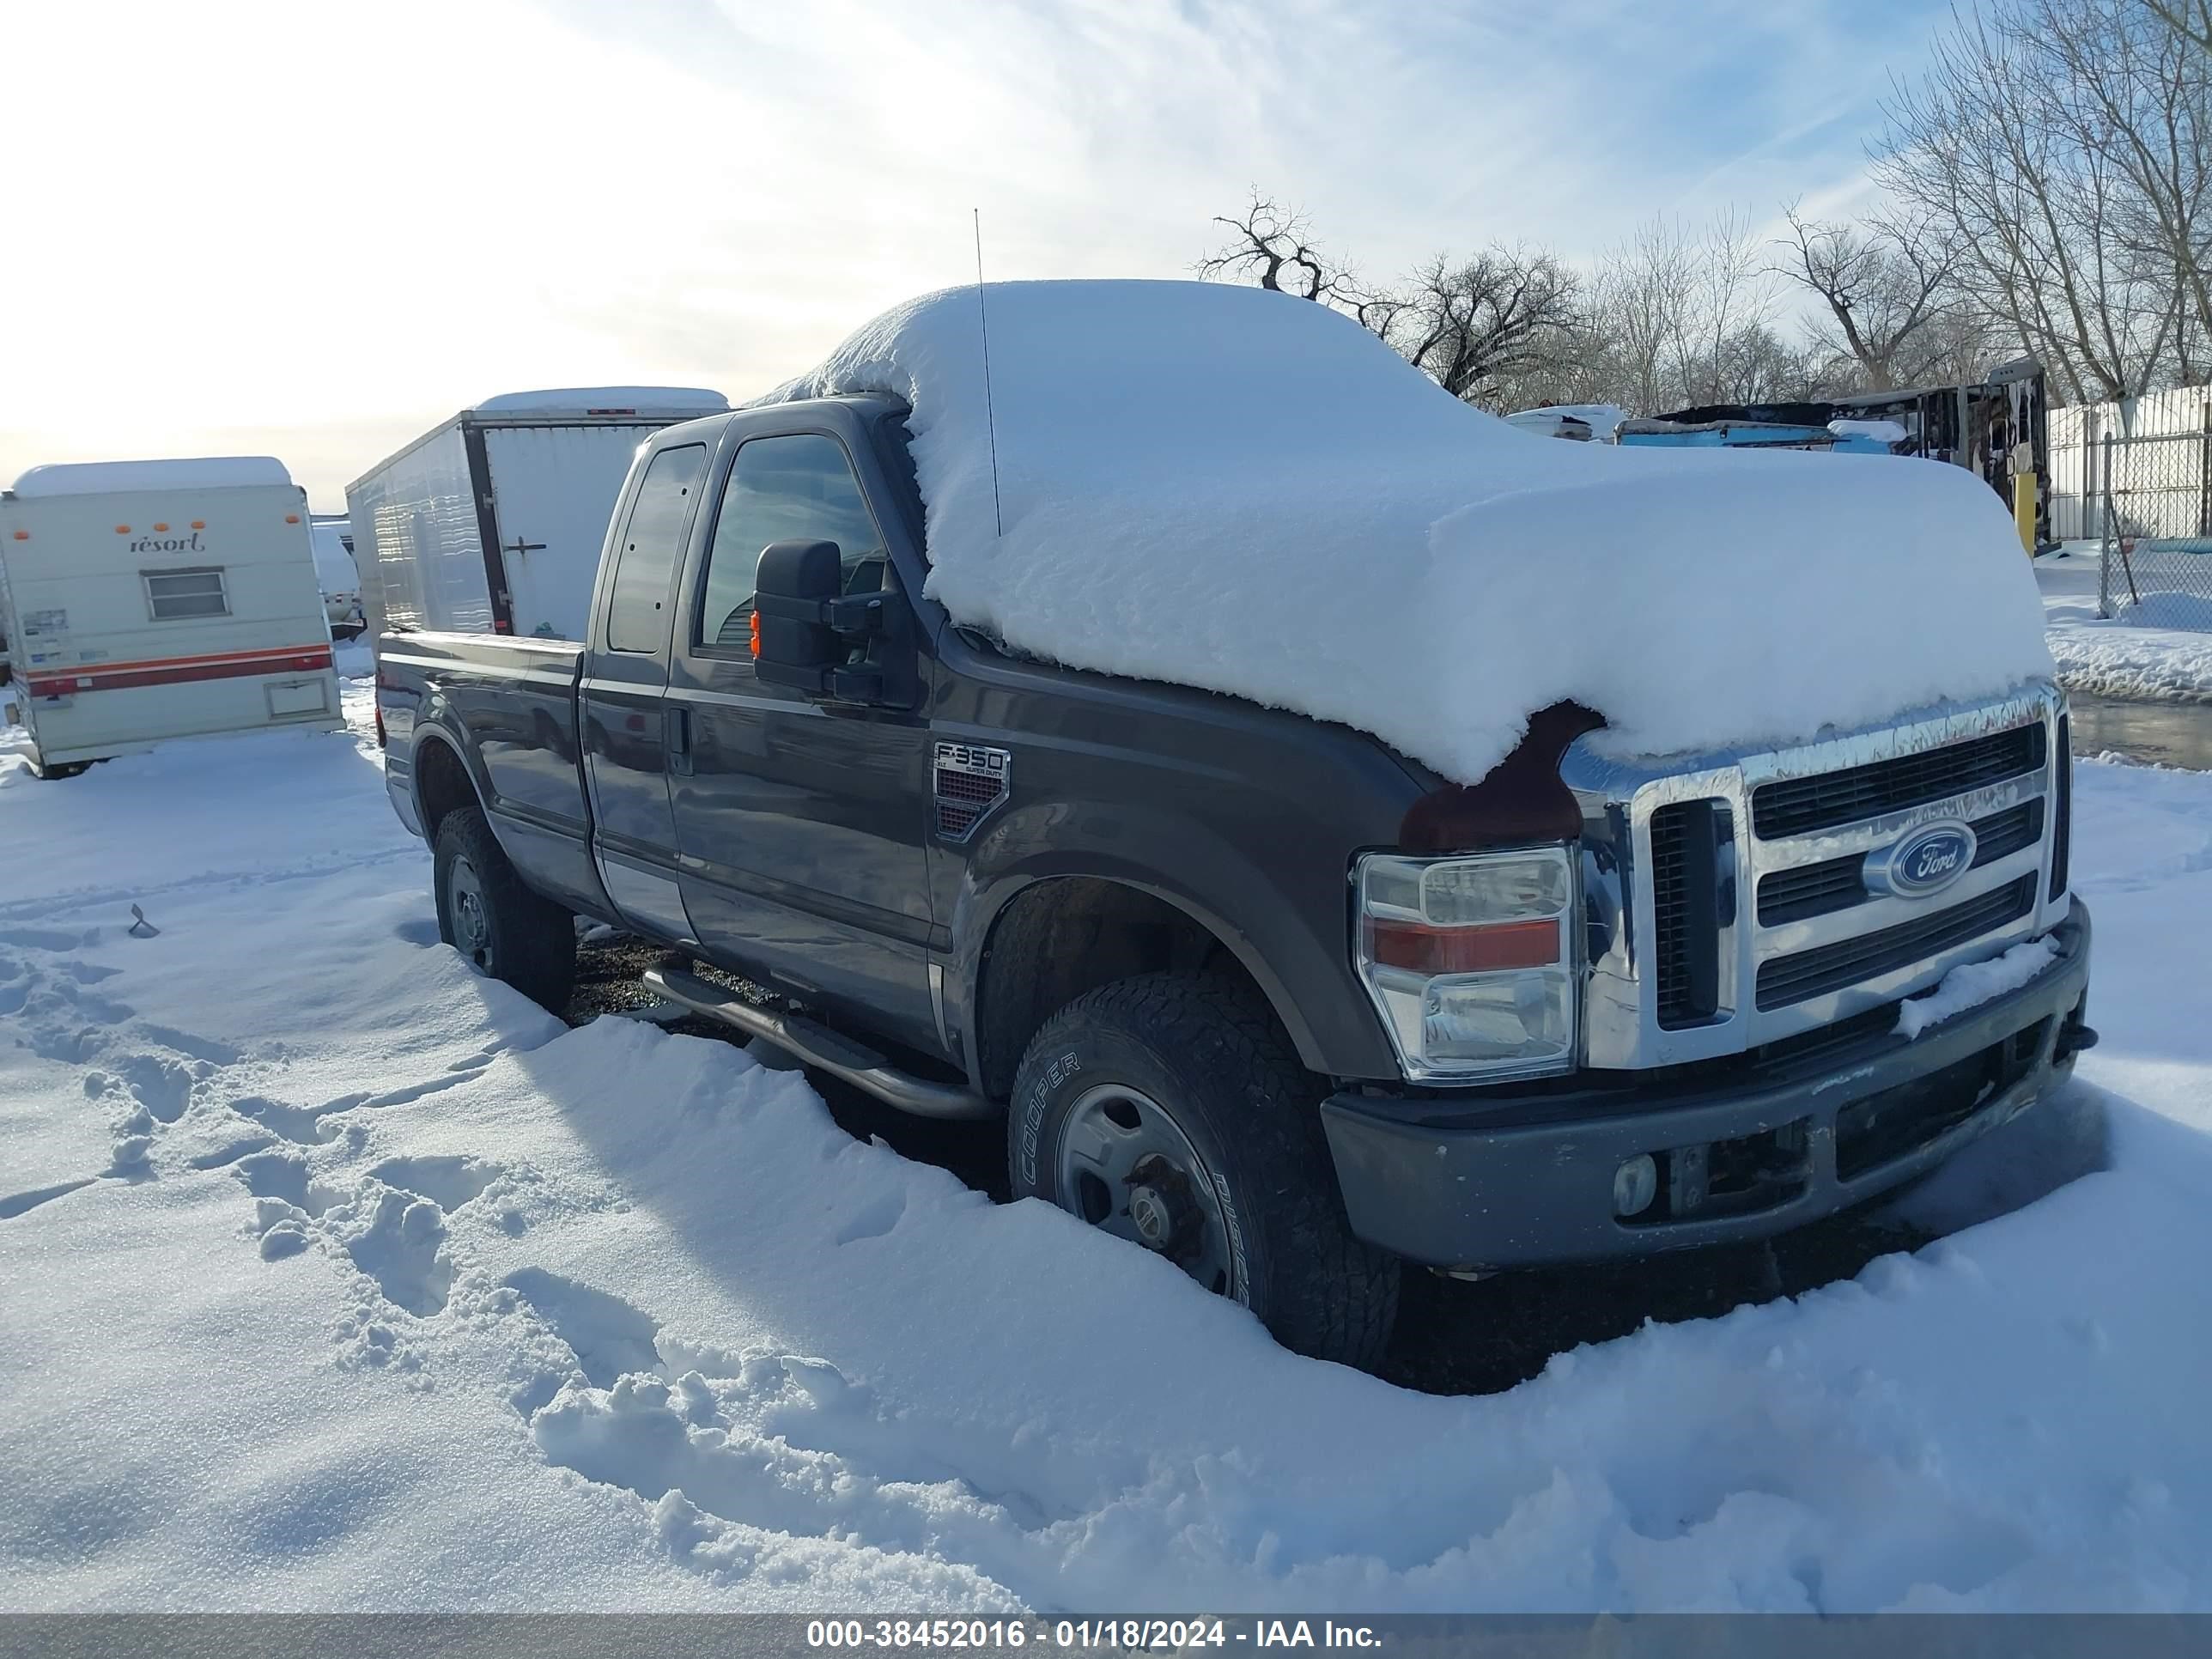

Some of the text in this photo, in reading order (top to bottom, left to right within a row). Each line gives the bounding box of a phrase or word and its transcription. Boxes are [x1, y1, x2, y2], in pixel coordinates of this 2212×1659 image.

[966, 766, 1002, 778] SUPER DUTY
[1917, 841, 1959, 878] Ford
[1022, 1051, 1081, 1186] COOPER
